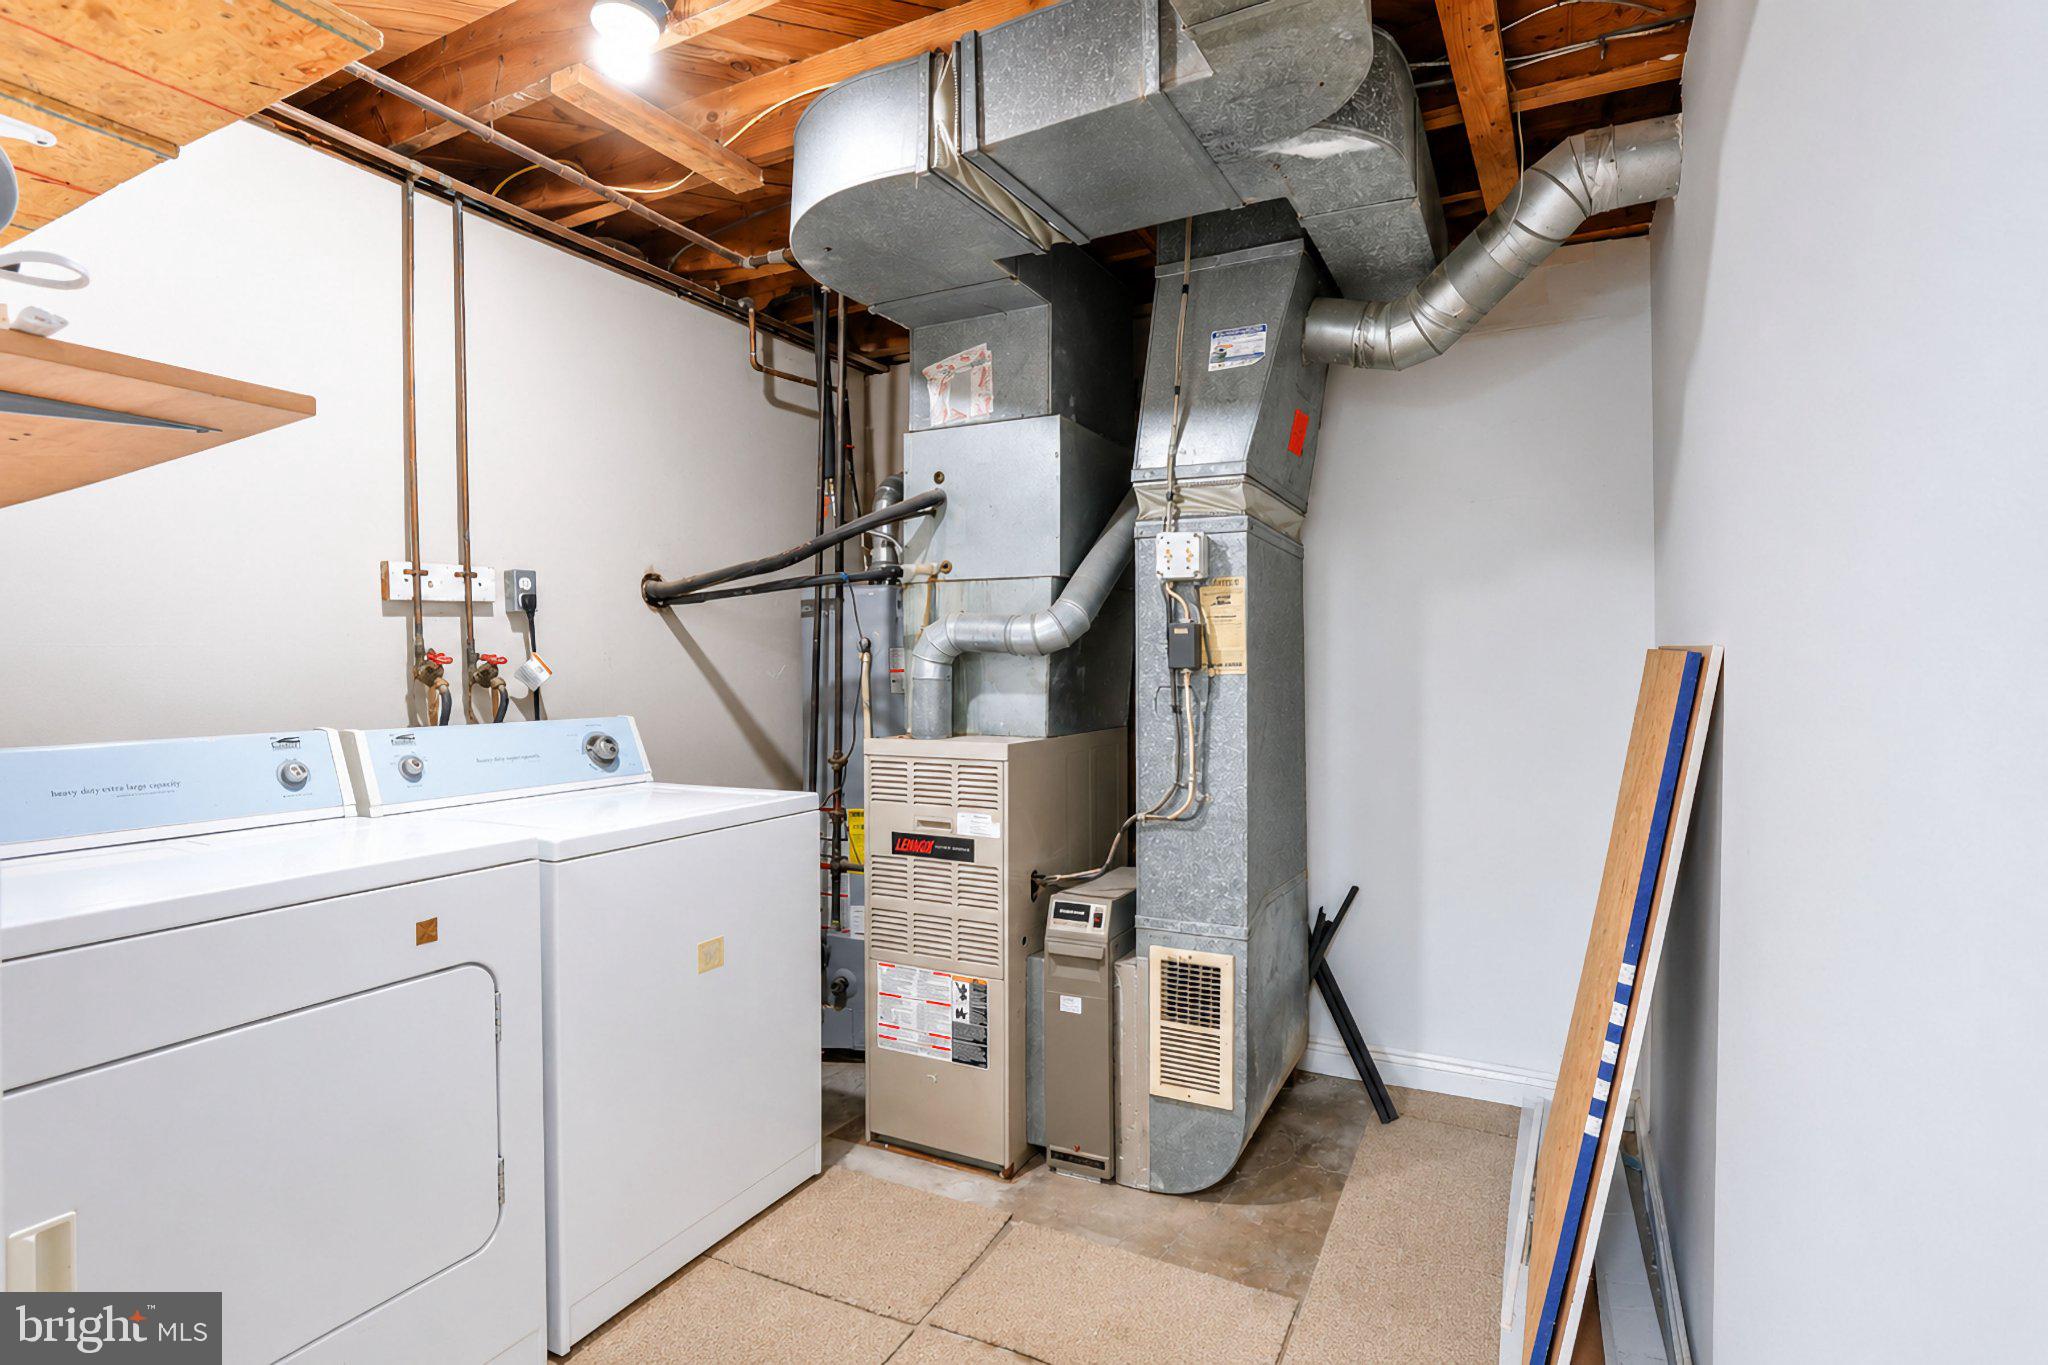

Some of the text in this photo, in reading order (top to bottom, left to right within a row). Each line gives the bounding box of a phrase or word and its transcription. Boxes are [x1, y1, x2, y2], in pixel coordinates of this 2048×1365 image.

[51, 779, 181, 798] heavy duty extra large capacity
[895, 837, 935, 855] LENNOX
